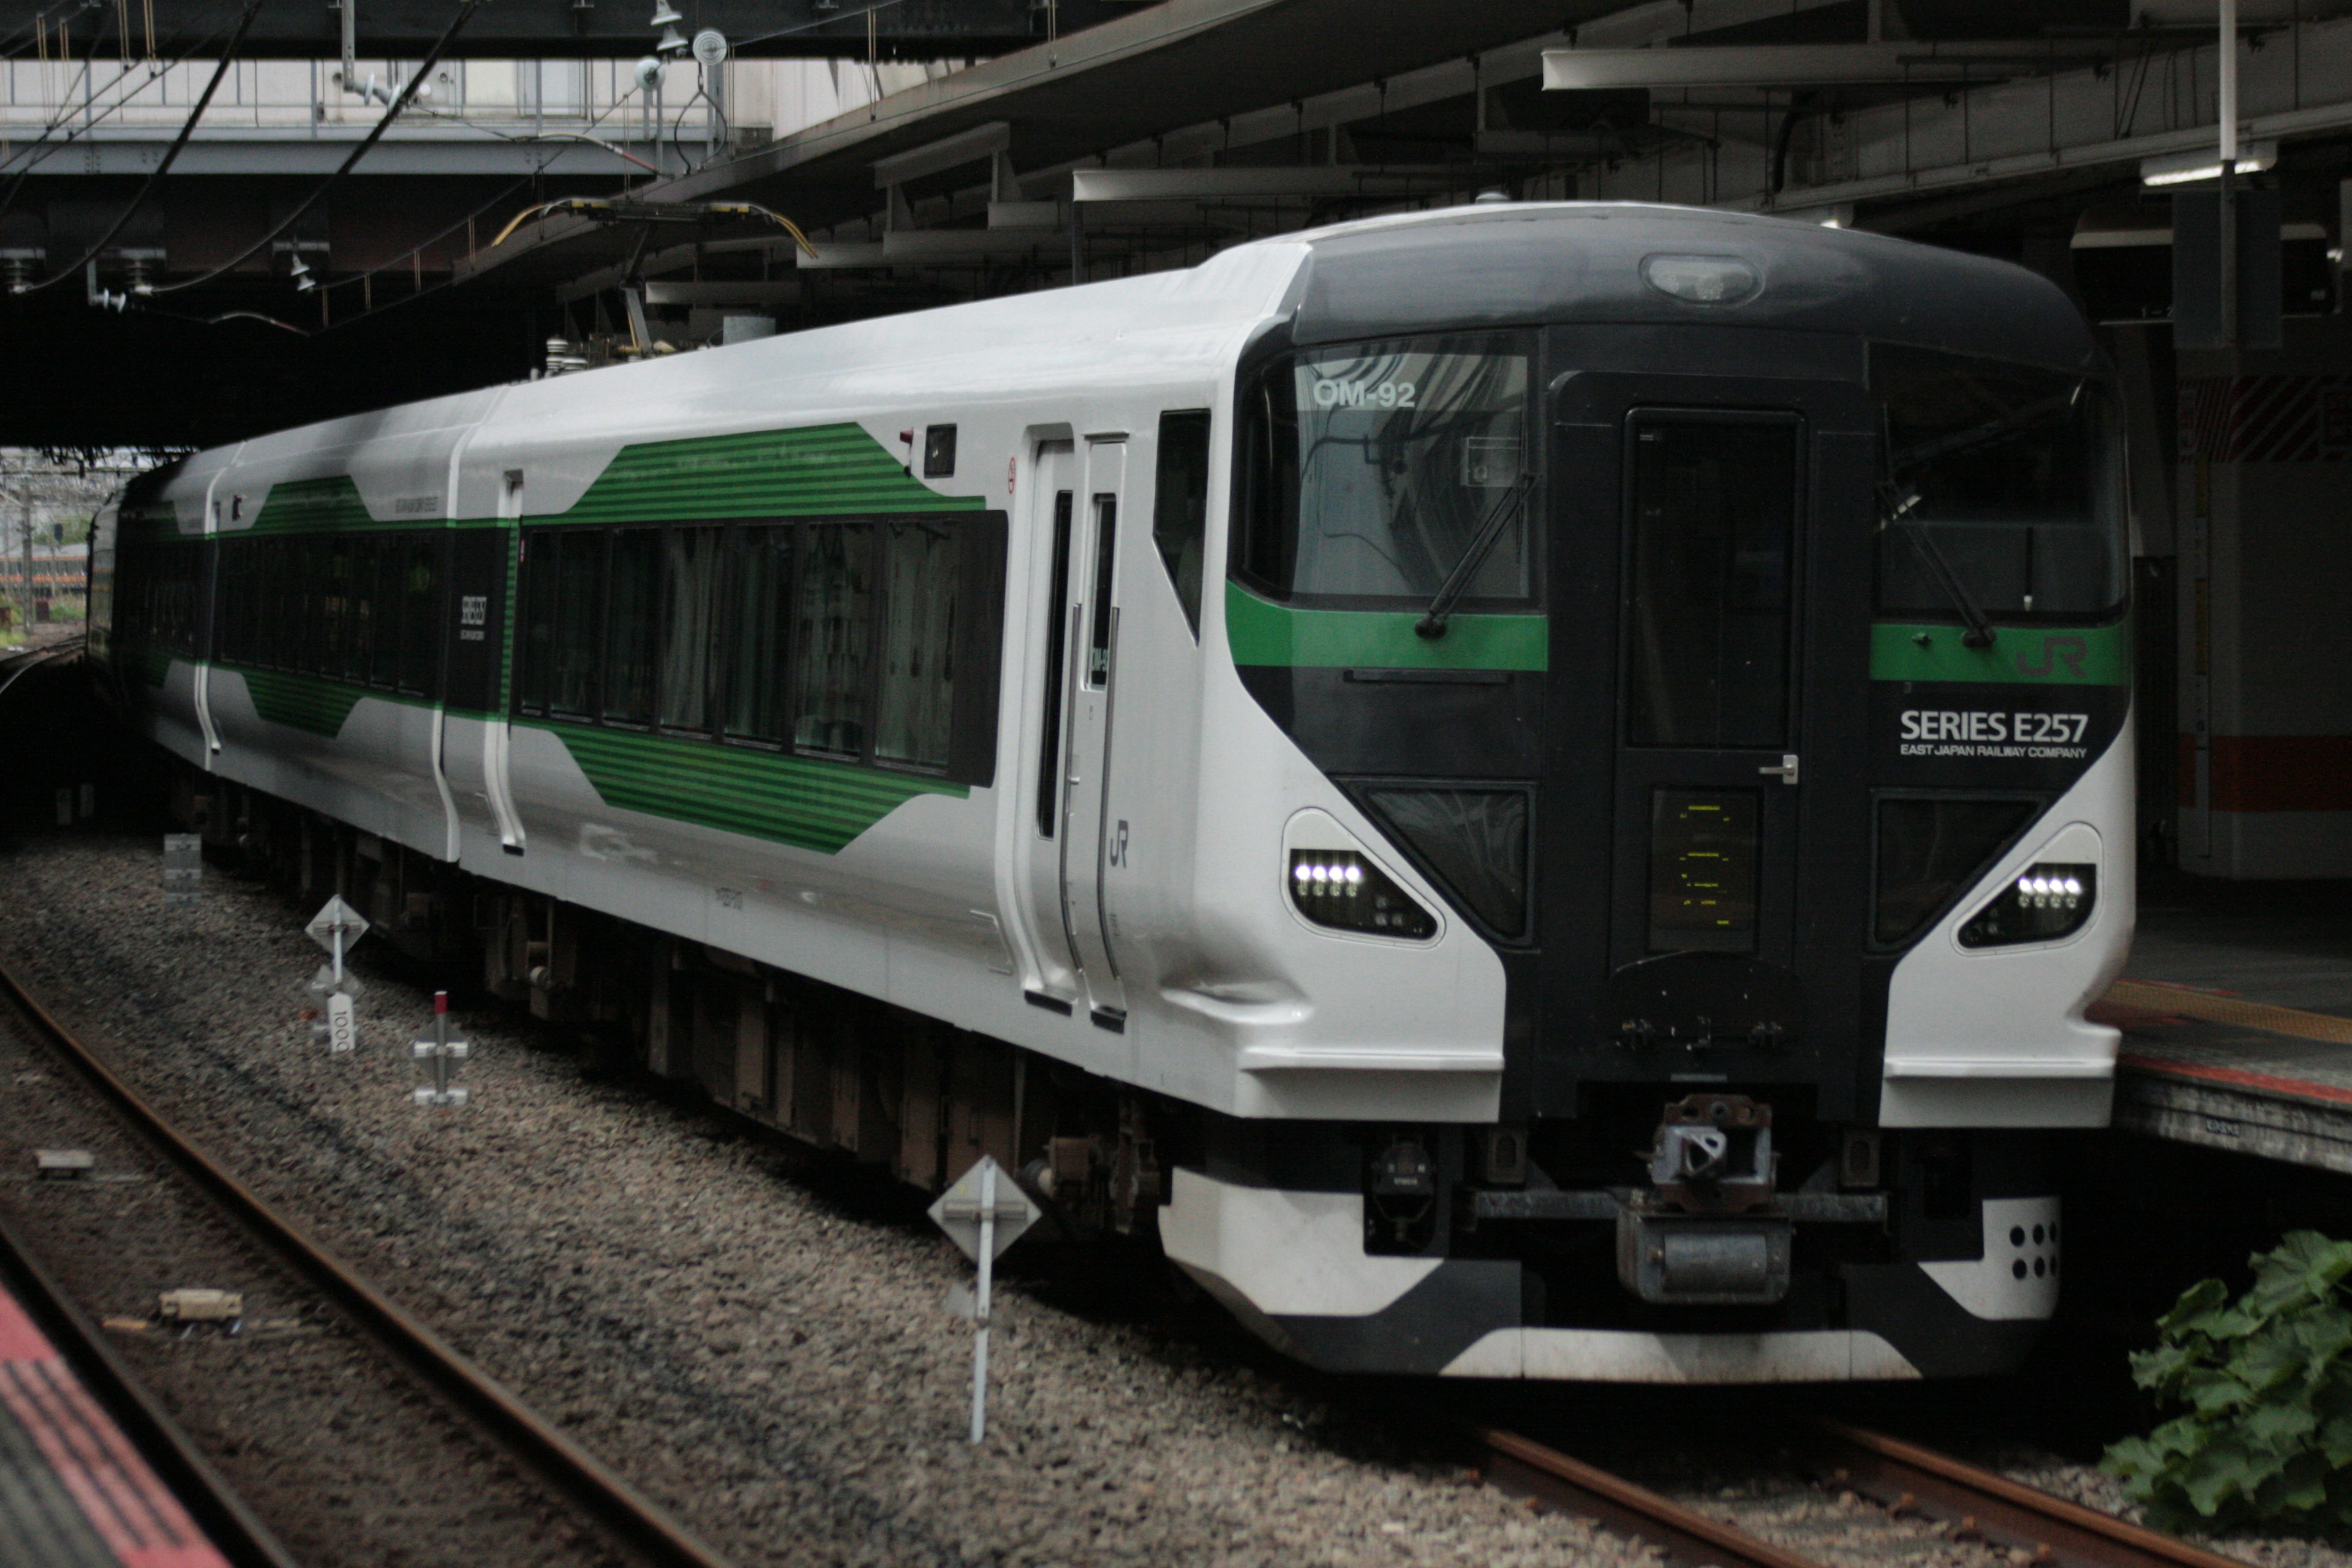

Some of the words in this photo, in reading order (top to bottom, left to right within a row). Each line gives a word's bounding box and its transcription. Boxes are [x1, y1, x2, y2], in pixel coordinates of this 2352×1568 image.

[1313, 379, 1415, 408] OM-92
[2015, 635, 2088, 678] JR
[1901, 710, 2007, 742] SERIES
[2014, 713, 2089, 743] E257
[1900, 744, 1934, 756] EAST
[1934, 745, 1975, 756] JAPAN
[1977, 746, 2027, 758] RAILWAY
[2028, 747, 2087, 759] COMPANY
[1110, 820, 1129, 869] JR
